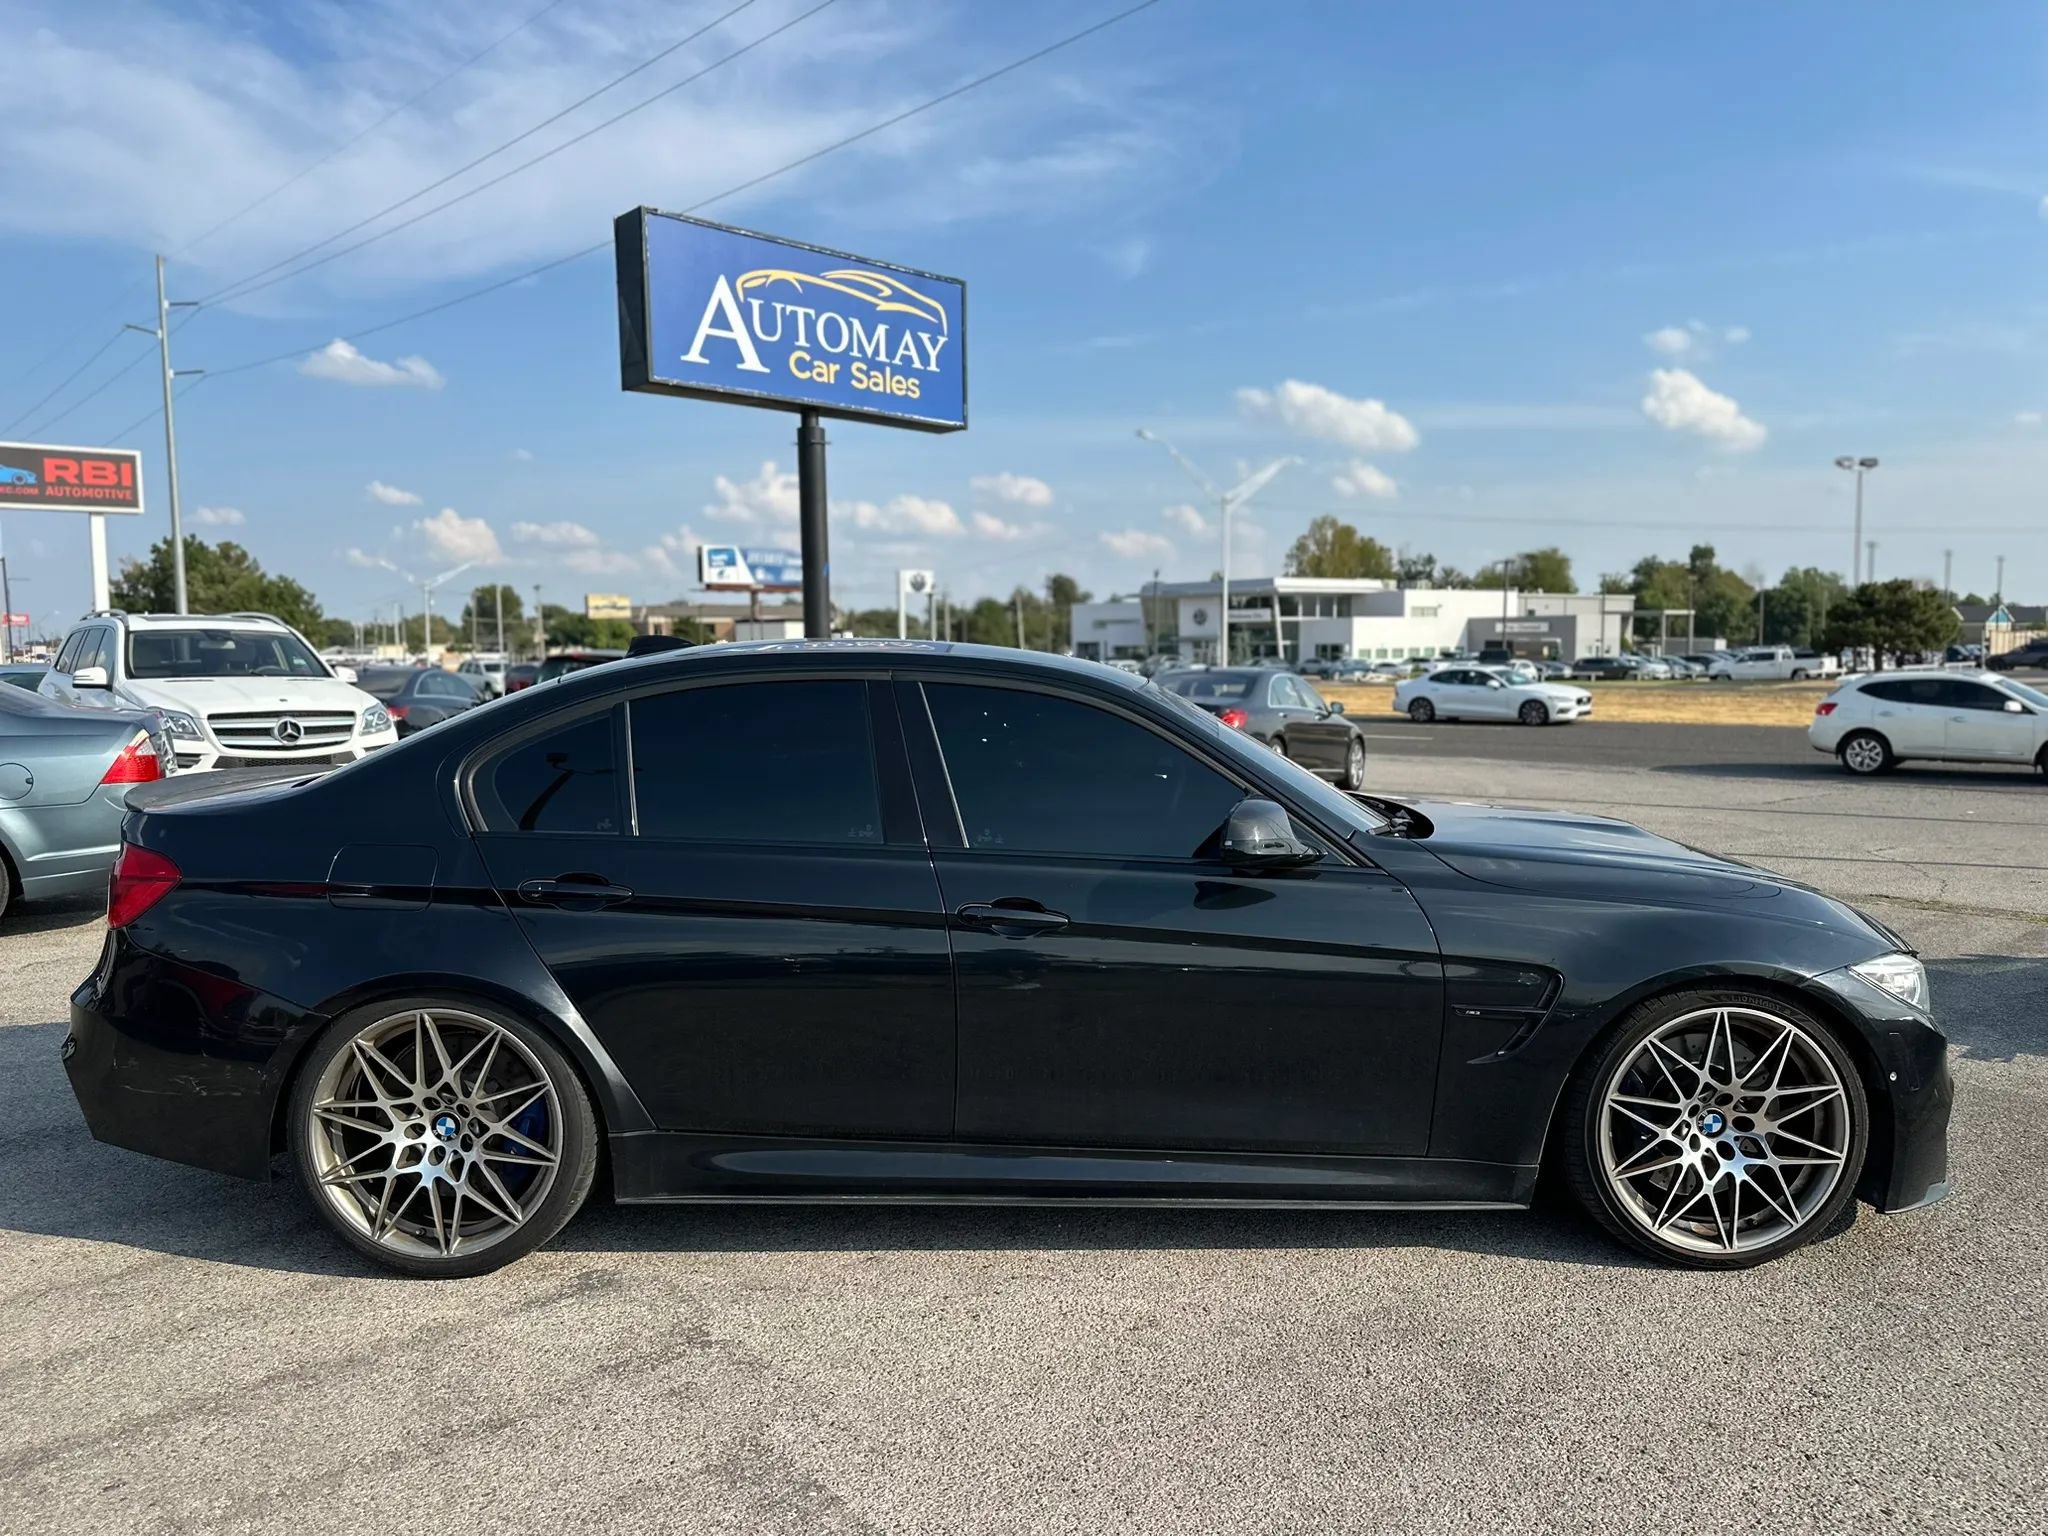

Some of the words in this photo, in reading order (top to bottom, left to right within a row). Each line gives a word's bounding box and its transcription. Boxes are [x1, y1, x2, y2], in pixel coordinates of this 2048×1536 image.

[788, 350, 840, 385] Car
[851, 361, 921, 399] Sales
[43, 458, 133, 487] RBI
[45, 486, 133, 500] AUTOMOTIVE
